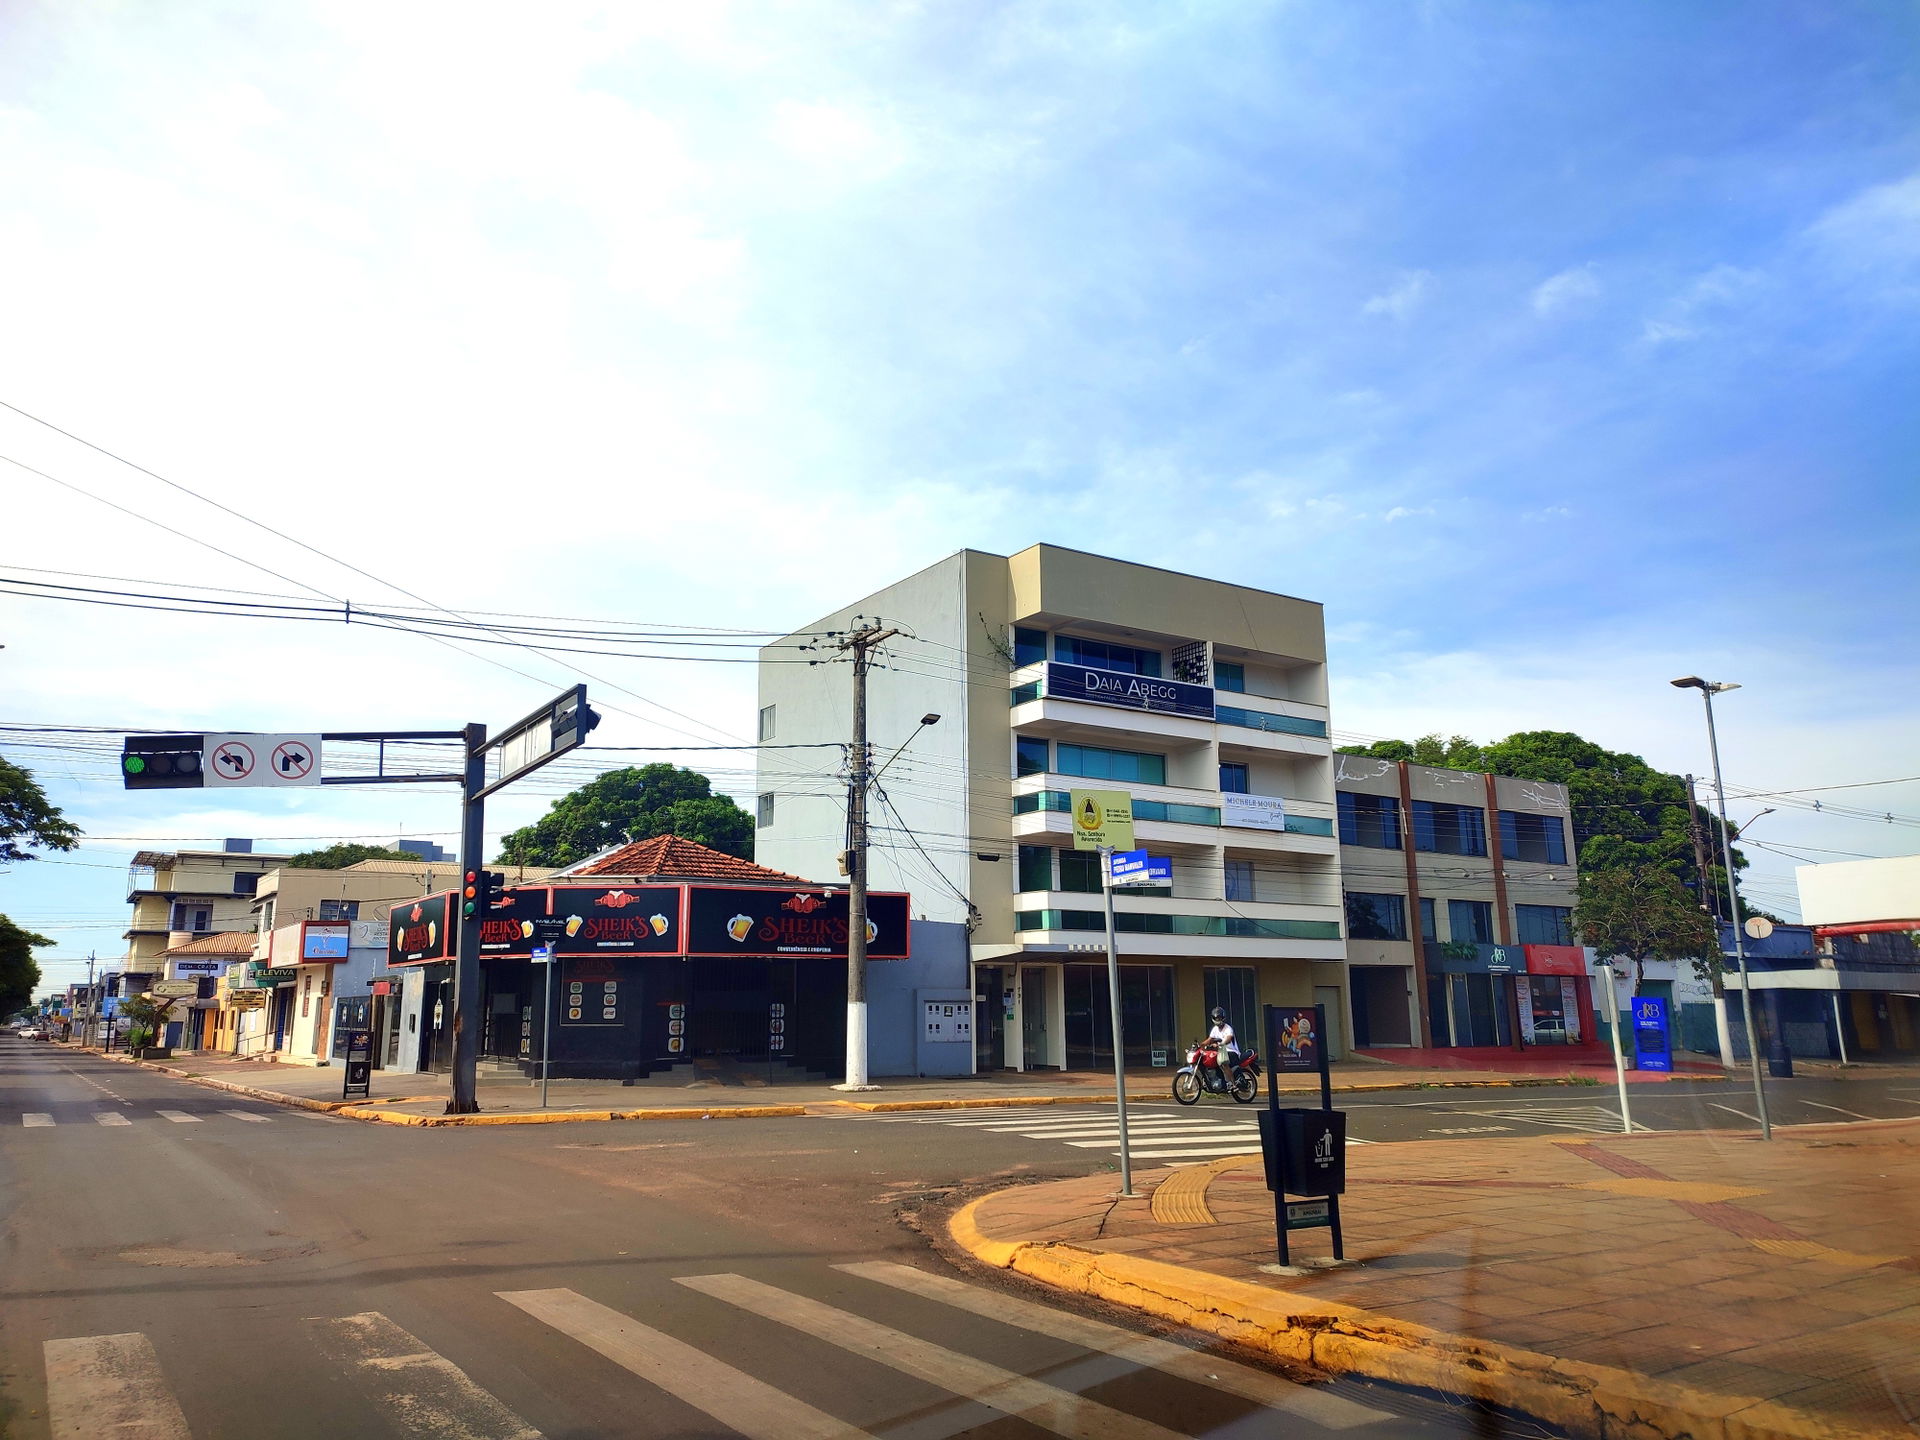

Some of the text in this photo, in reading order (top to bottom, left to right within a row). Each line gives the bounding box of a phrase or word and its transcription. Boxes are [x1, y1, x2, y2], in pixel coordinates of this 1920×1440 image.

[1085, 671, 1177, 700] DAIA ABEGG
[480, 917, 522, 941] HEIK'S
[584, 915, 650, 939] SHEIK'S
